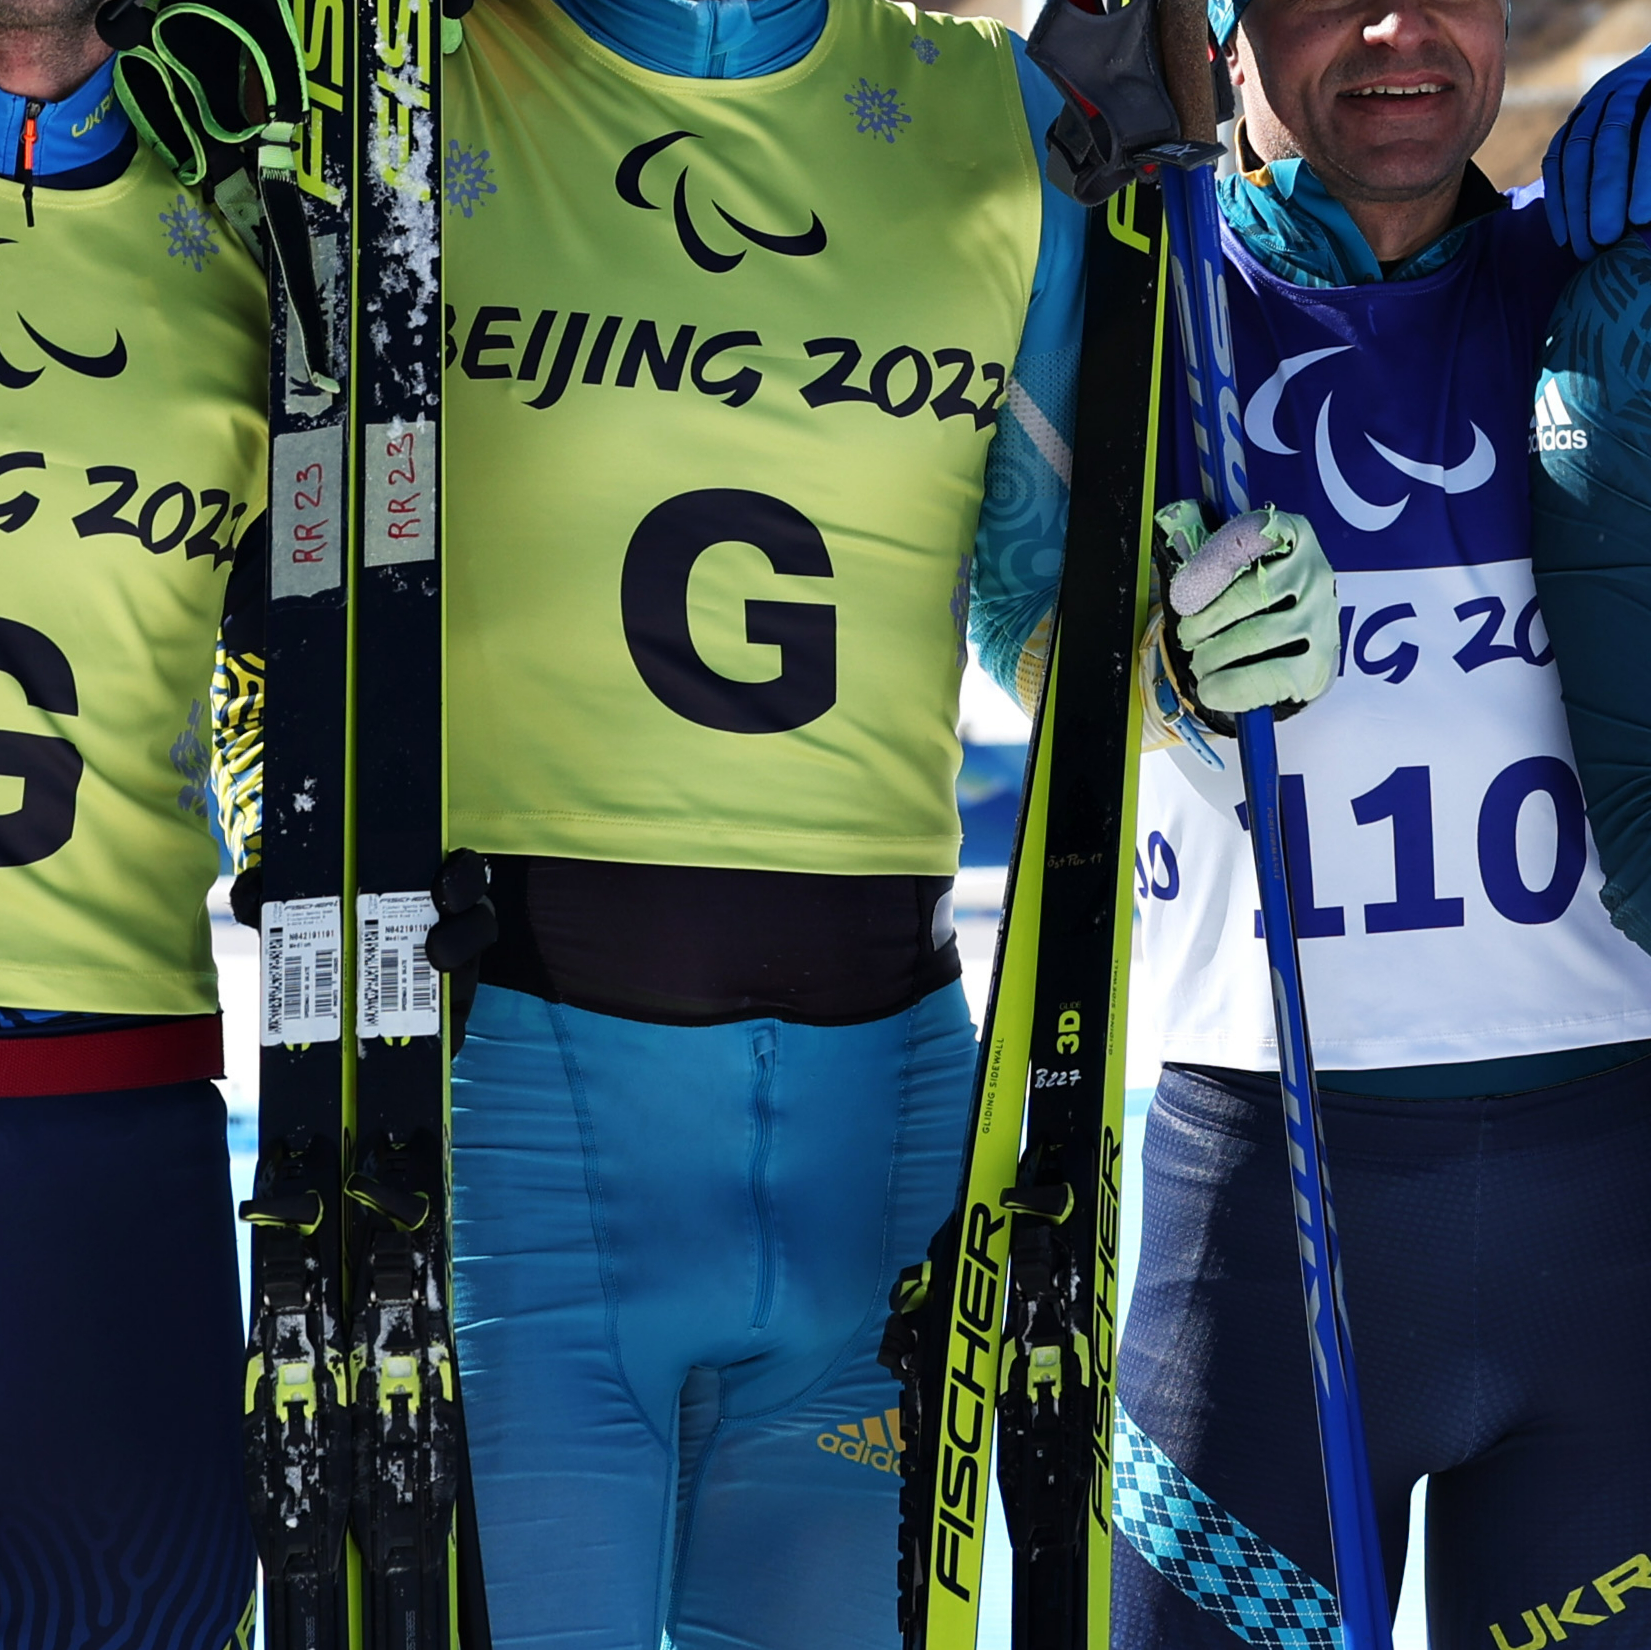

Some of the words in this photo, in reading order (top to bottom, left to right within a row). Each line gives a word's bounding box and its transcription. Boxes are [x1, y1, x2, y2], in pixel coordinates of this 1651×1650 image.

[620, 488, 838, 735] G
[1235, 756, 1588, 940] 110
[982, 1092, 996, 1134] GLIDING
[990, 1038, 1005, 1088] SIDEWALL
[1056, 1010, 1081, 1055] 3D
[934, 1203, 1008, 1603] FISCHER
[1092, 1125, 1122, 1534] FISCHER
[817, 1433, 901, 1477] adid
